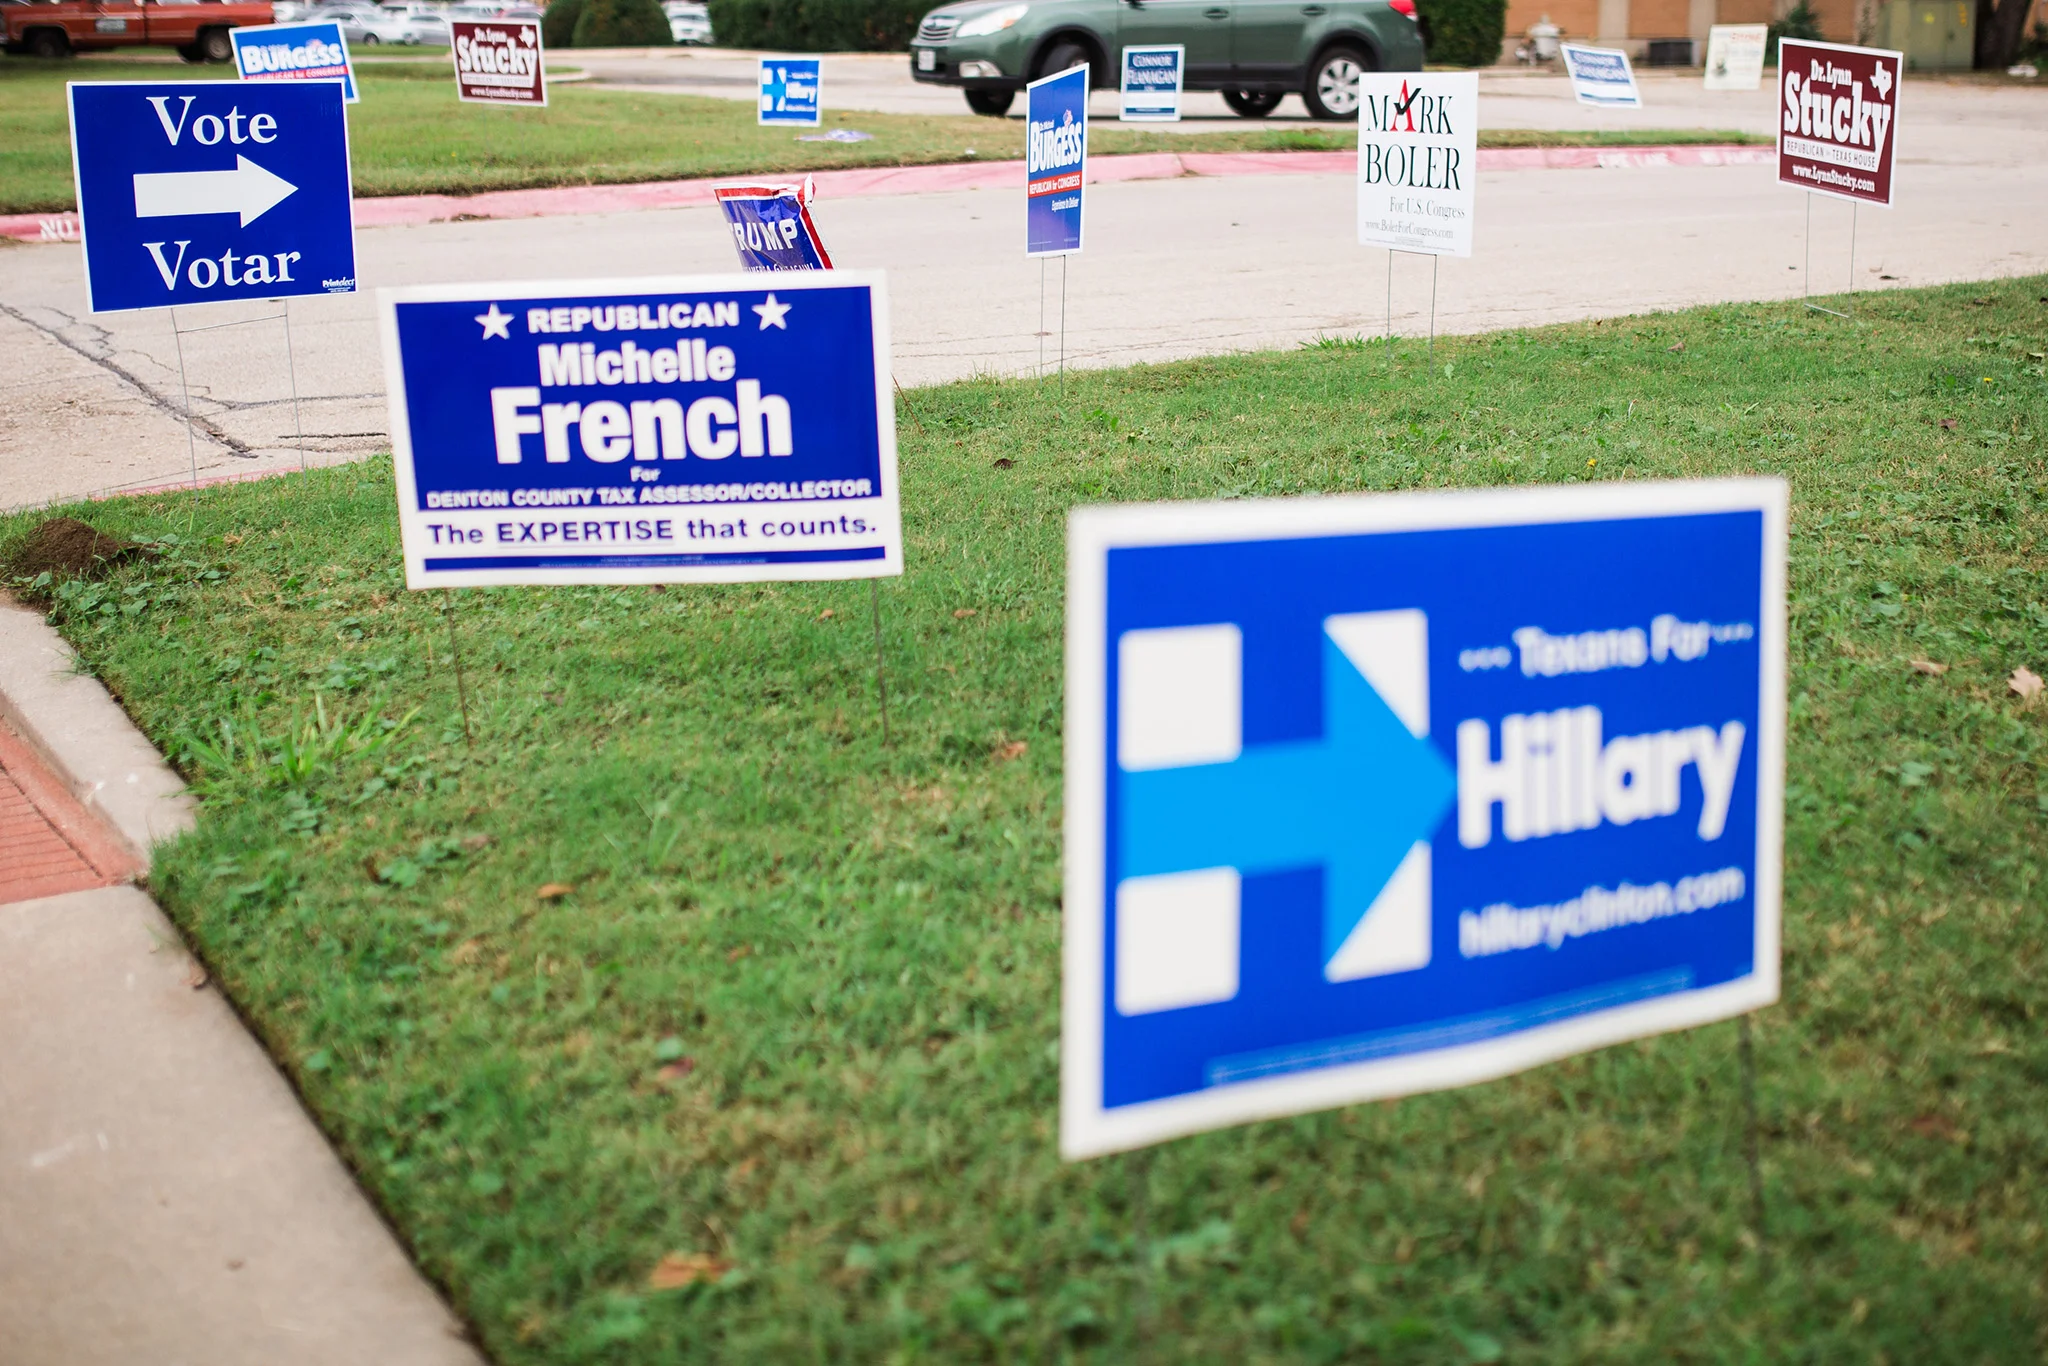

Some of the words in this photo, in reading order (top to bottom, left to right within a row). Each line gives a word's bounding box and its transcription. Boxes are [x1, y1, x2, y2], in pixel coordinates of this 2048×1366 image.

[241, 44, 342, 73] BURGESS
[457, 35, 537, 80] Stucky
[1133, 54, 1173, 68] CONNOR
[1811, 58, 1826, 83] Dr.
[1827, 60, 1852, 90] Lynn
[1127, 69, 1177, 84] FLANAGAN
[146, 95, 278, 146] Vote
[1367, 79, 1454, 135] MARK
[1784, 70, 1891, 160] Stucky
[1030, 121, 1083, 174] BURGESS
[1786, 140, 1824, 157] REPUBLICAN
[1832, 149, 1852, 163] TEXAS
[1853, 154, 1876, 168] HOUSE
[1364, 143, 1461, 191] BOLER
[1792, 163, 1876, 192] www.LynnStucky.com
[1029, 180, 1052, 195] REPUBLICAN
[1058, 175, 1081, 189] CONGRESS
[1390, 196, 1405, 212] For
[1406, 197, 1424, 215] U.S.
[1426, 199, 1466, 221] Congress
[39, 218, 75, 240] NO
[727, 218, 798, 251] RUMP
[1364, 219, 1455, 239] www.BolerForCongress.com
[142, 240, 302, 291] Votar
[527, 301, 741, 335] REPUBLICAN
[538, 338, 736, 387] Michelle
[490, 378, 794, 465] French
[630, 466, 661, 483] For
[427, 491, 510, 508] DENTON
[512, 488, 593, 507] COUNTY
[597, 487, 637, 505] TAX
[638, 479, 873, 505] ASSESSOR/COLLECTOR
[426, 523, 485, 545] The
[498, 519, 675, 545] EXPERTISE
[687, 517, 749, 540] that
[762, 514, 879, 538] counts.
[1511, 625, 1649, 679] Texans
[1651, 613, 1711, 664] For
[1455, 703, 1748, 850] Hillary
[1458, 865, 1747, 960] hillaryclinton.com
